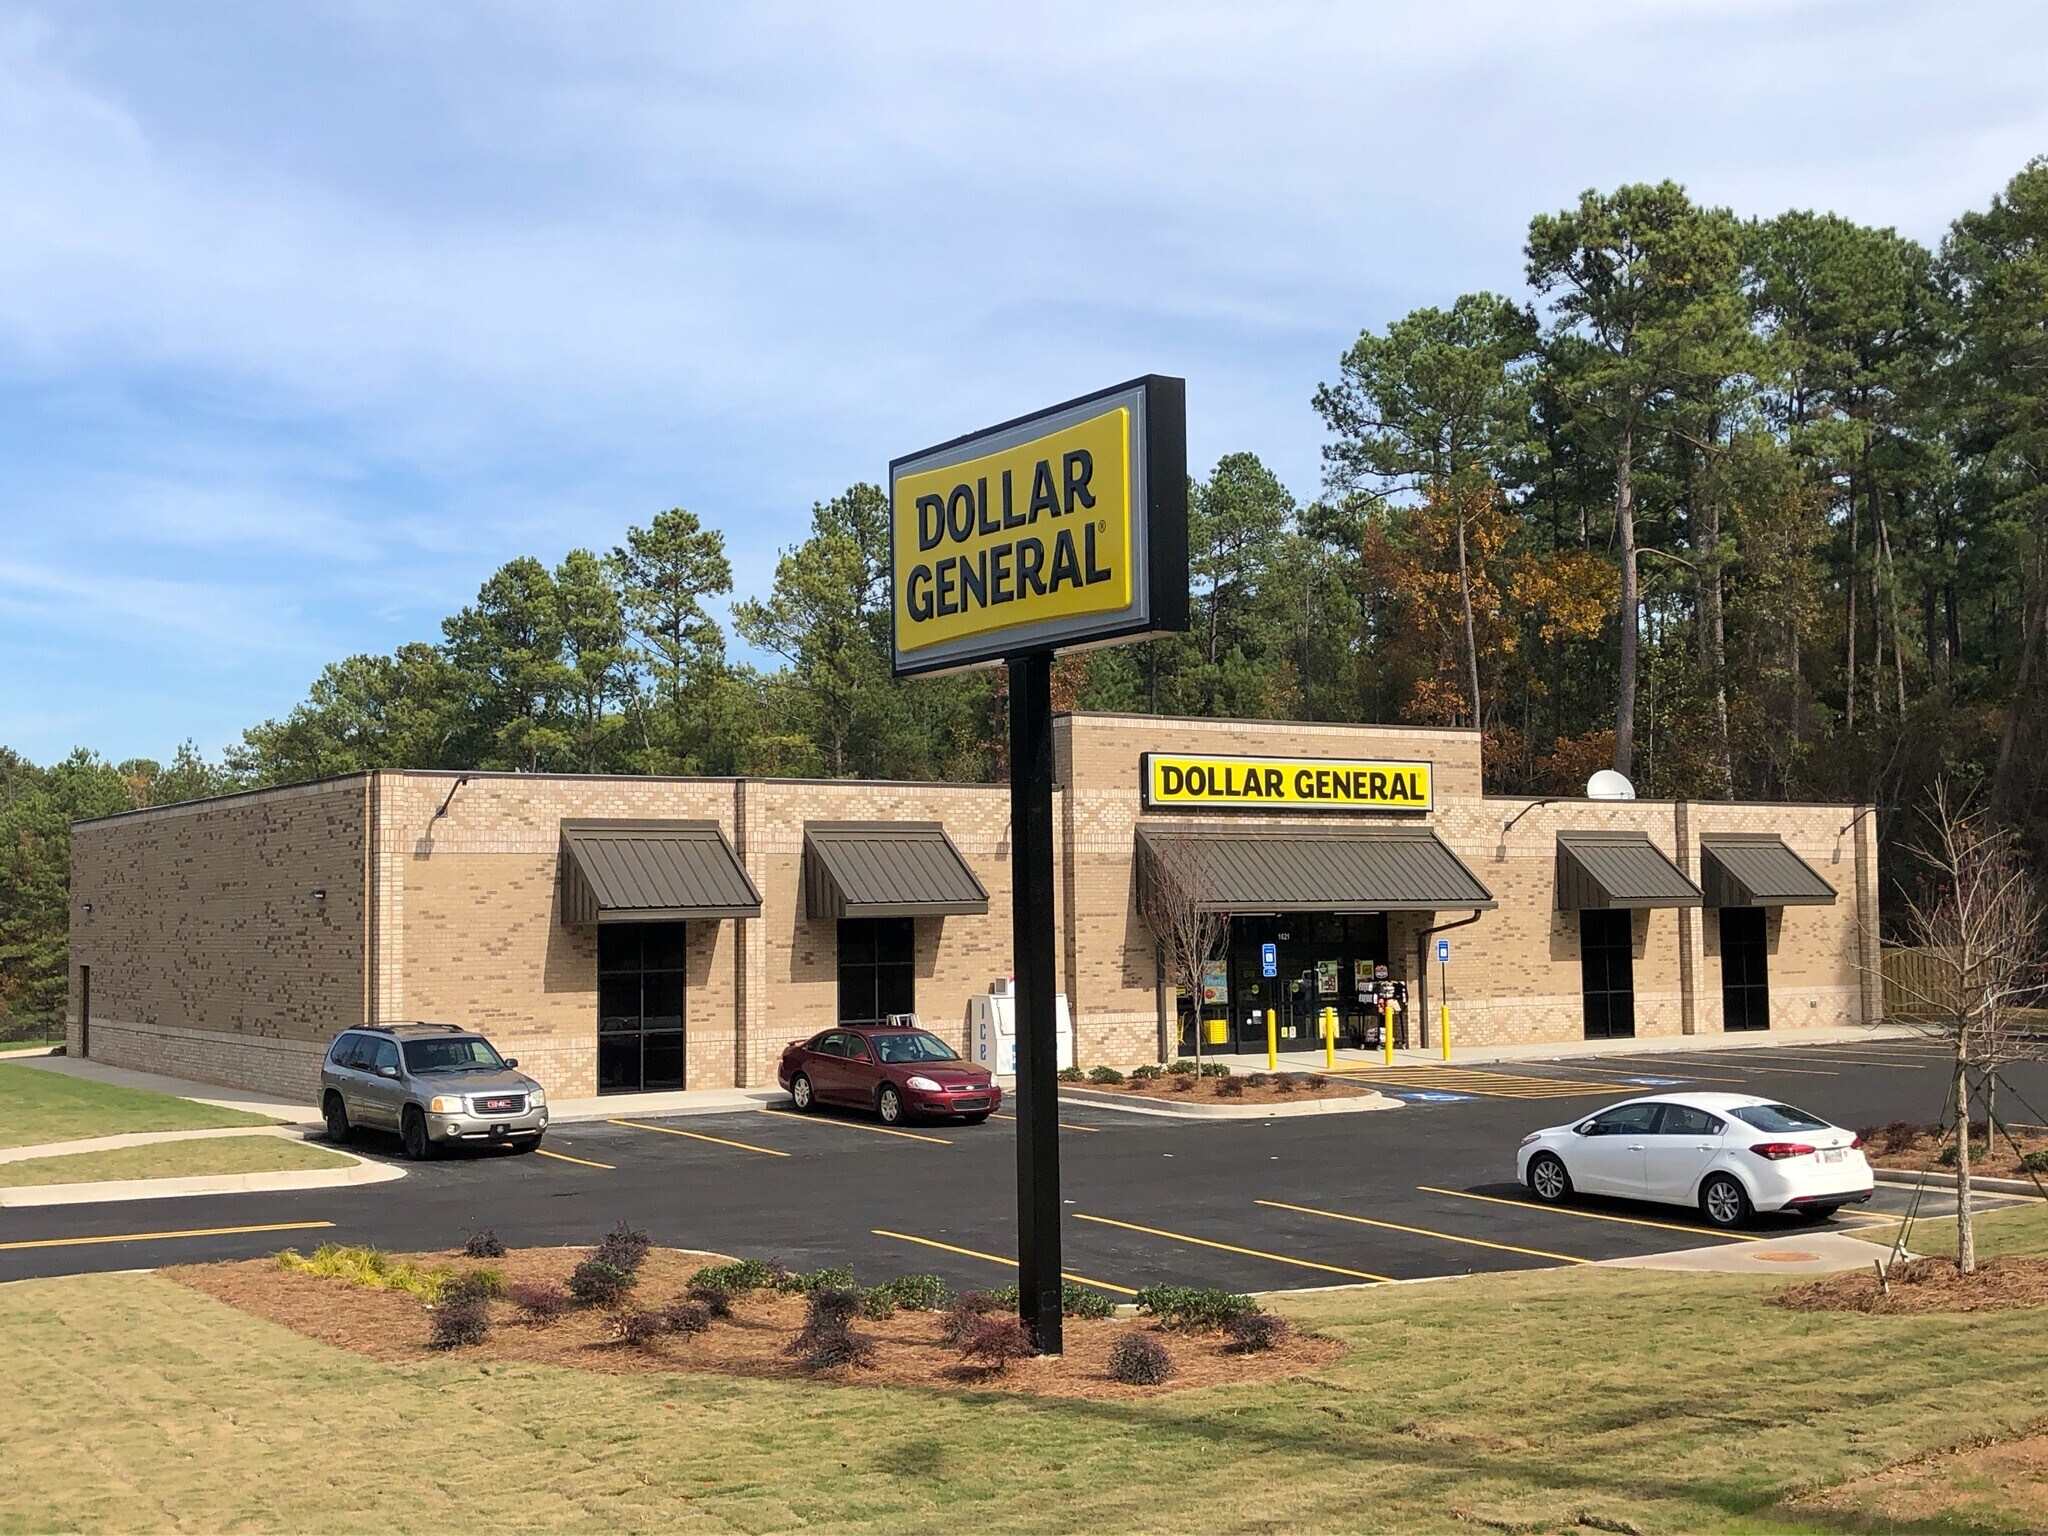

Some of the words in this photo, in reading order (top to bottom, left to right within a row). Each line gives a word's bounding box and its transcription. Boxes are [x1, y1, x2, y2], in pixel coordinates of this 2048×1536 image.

[915, 449, 1096, 552] DOLLAR
[1161, 765, 1284, 798] DOLLAR
[1294, 769, 1424, 801] GENERAL
